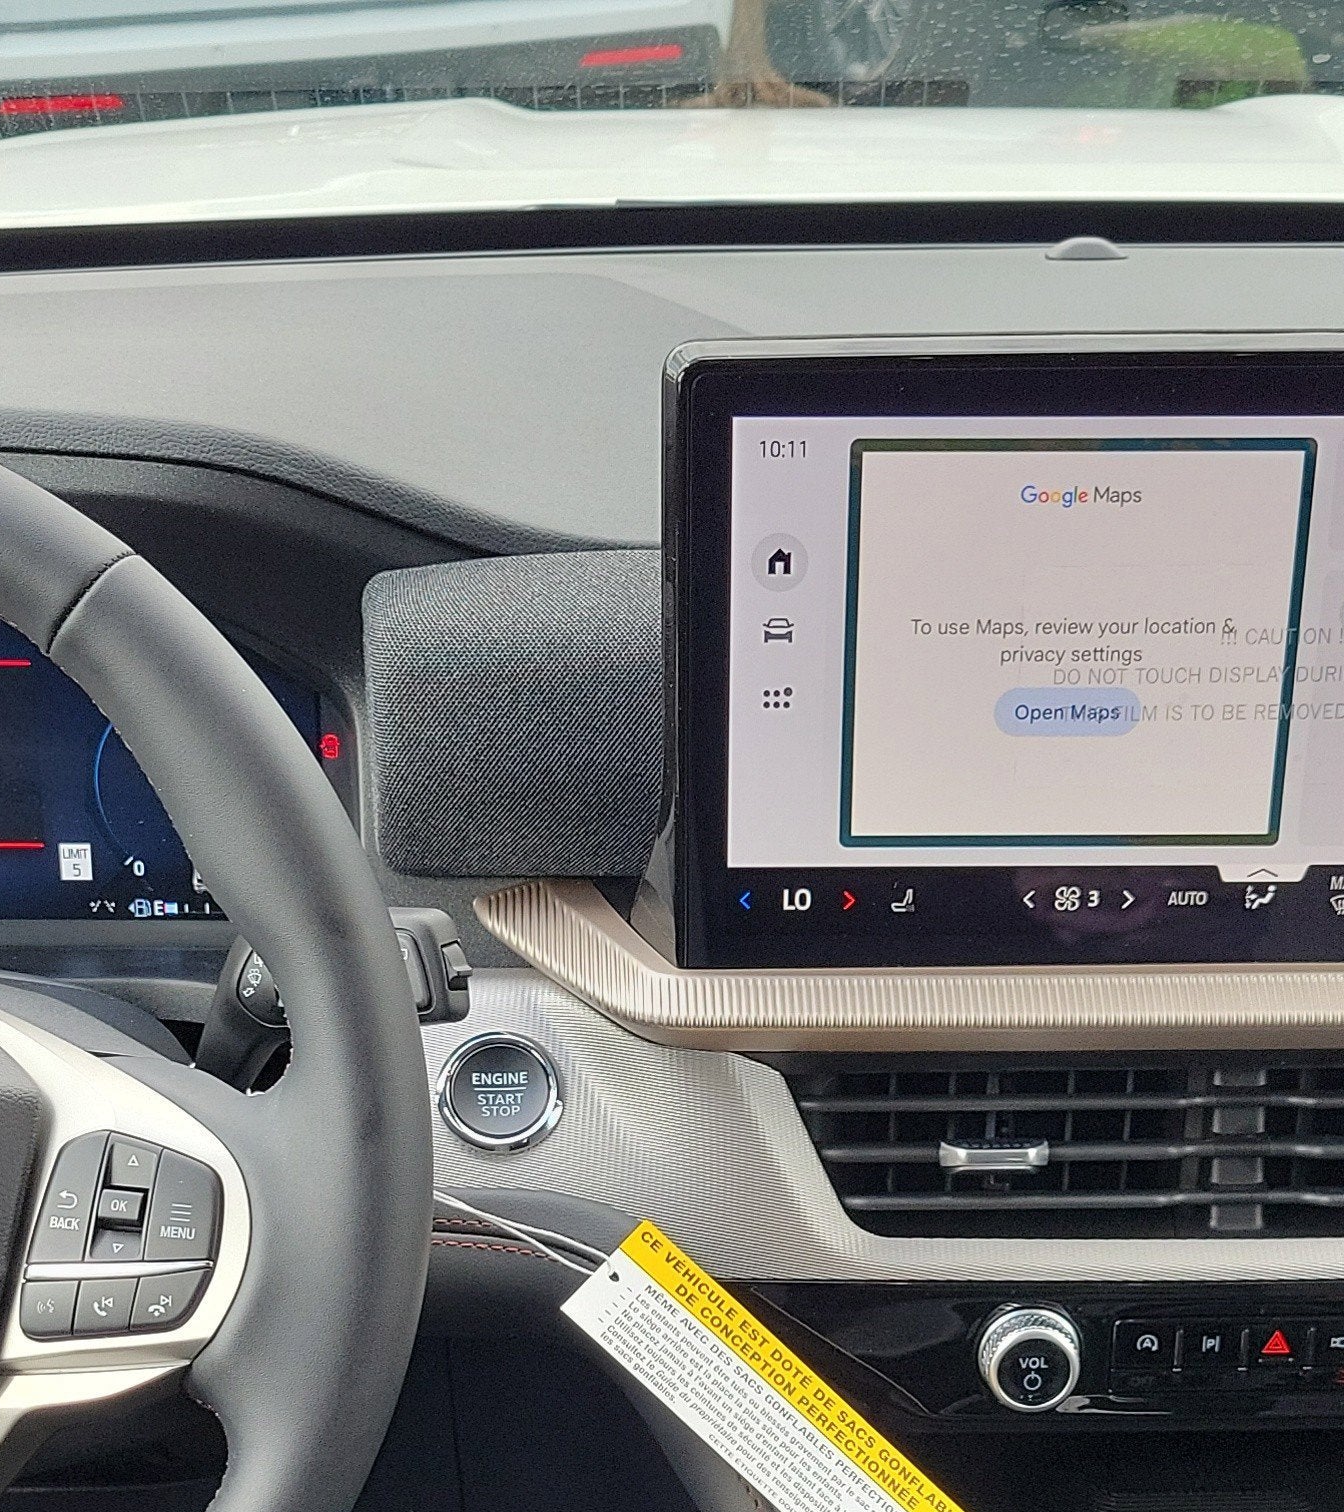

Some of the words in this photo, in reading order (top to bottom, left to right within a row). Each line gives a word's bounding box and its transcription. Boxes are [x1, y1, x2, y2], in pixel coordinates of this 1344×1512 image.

[758, 440, 807, 458] 10:11
[1020, 485, 1088, 508] Google
[1093, 485, 1143, 508] Maps
[911, 618, 932, 635] To
[938, 622, 970, 635] use
[976, 618, 1030, 639] Maps,
[1035, 618, 1091, 635] review
[1098, 621, 1139, 638] your
[1144, 617, 1215, 635] location
[1221, 618, 1237, 635] &
[1245, 627, 1332, 645] CAUTON
[1000, 646, 1065, 667] privacy
[1071, 646, 1143, 665] settings
[1053, 668, 1081, 686] DO
[1087, 667, 1129, 686] NOT
[1135, 666, 1201, 685] TOUCH
[1209, 665, 1290, 684] DISPLAY
[1014, 704, 1064, 724] Open
[1070, 704, 1121, 724] Maps
[1164, 704, 1183, 722] IS
[1189, 703, 1215, 722] TO
[1221, 703, 1247, 721] BE
[62, 848, 88, 860] LIMIT
[72, 863, 82, 877] 5
[133, 860, 145, 877] 0
[782, 889, 812, 911] LO
[1087, 892, 1099, 908] 3
[1167, 890, 1207, 906] AUTO
[471, 1071, 529, 1085] ENGINE
[477, 1093, 524, 1105] START
[481, 1105, 521, 1117] STOP
[110, 1200, 128, 1212] OK
[49, 1216, 80, 1231] BACK
[159, 1226, 196, 1240] MENU
[639, 1229, 664, 1253] CE
[662, 1248, 740, 1321] VÉHICULE
[737, 1319, 769, 1350] EST
[769, 1346, 814, 1390] DOTÉ
[812, 1387, 836, 1411] DE
[835, 1409, 877, 1449] SACS
[644, 1282, 681, 1318] MÊME
[679, 1316, 710, 1345] AVEC
[709, 1343, 733, 1367] DES
[732, 1364, 764, 1395] SACS
[763, 1393, 834, 1460] GONFLABLES
[1018, 1357, 1048, 1369] VOL
[674, 1283, 699, 1307] DE
[698, 1305, 797, 1397] CONCEPTION
[796, 1392, 921, 1510] PERFECTIONNÉE
